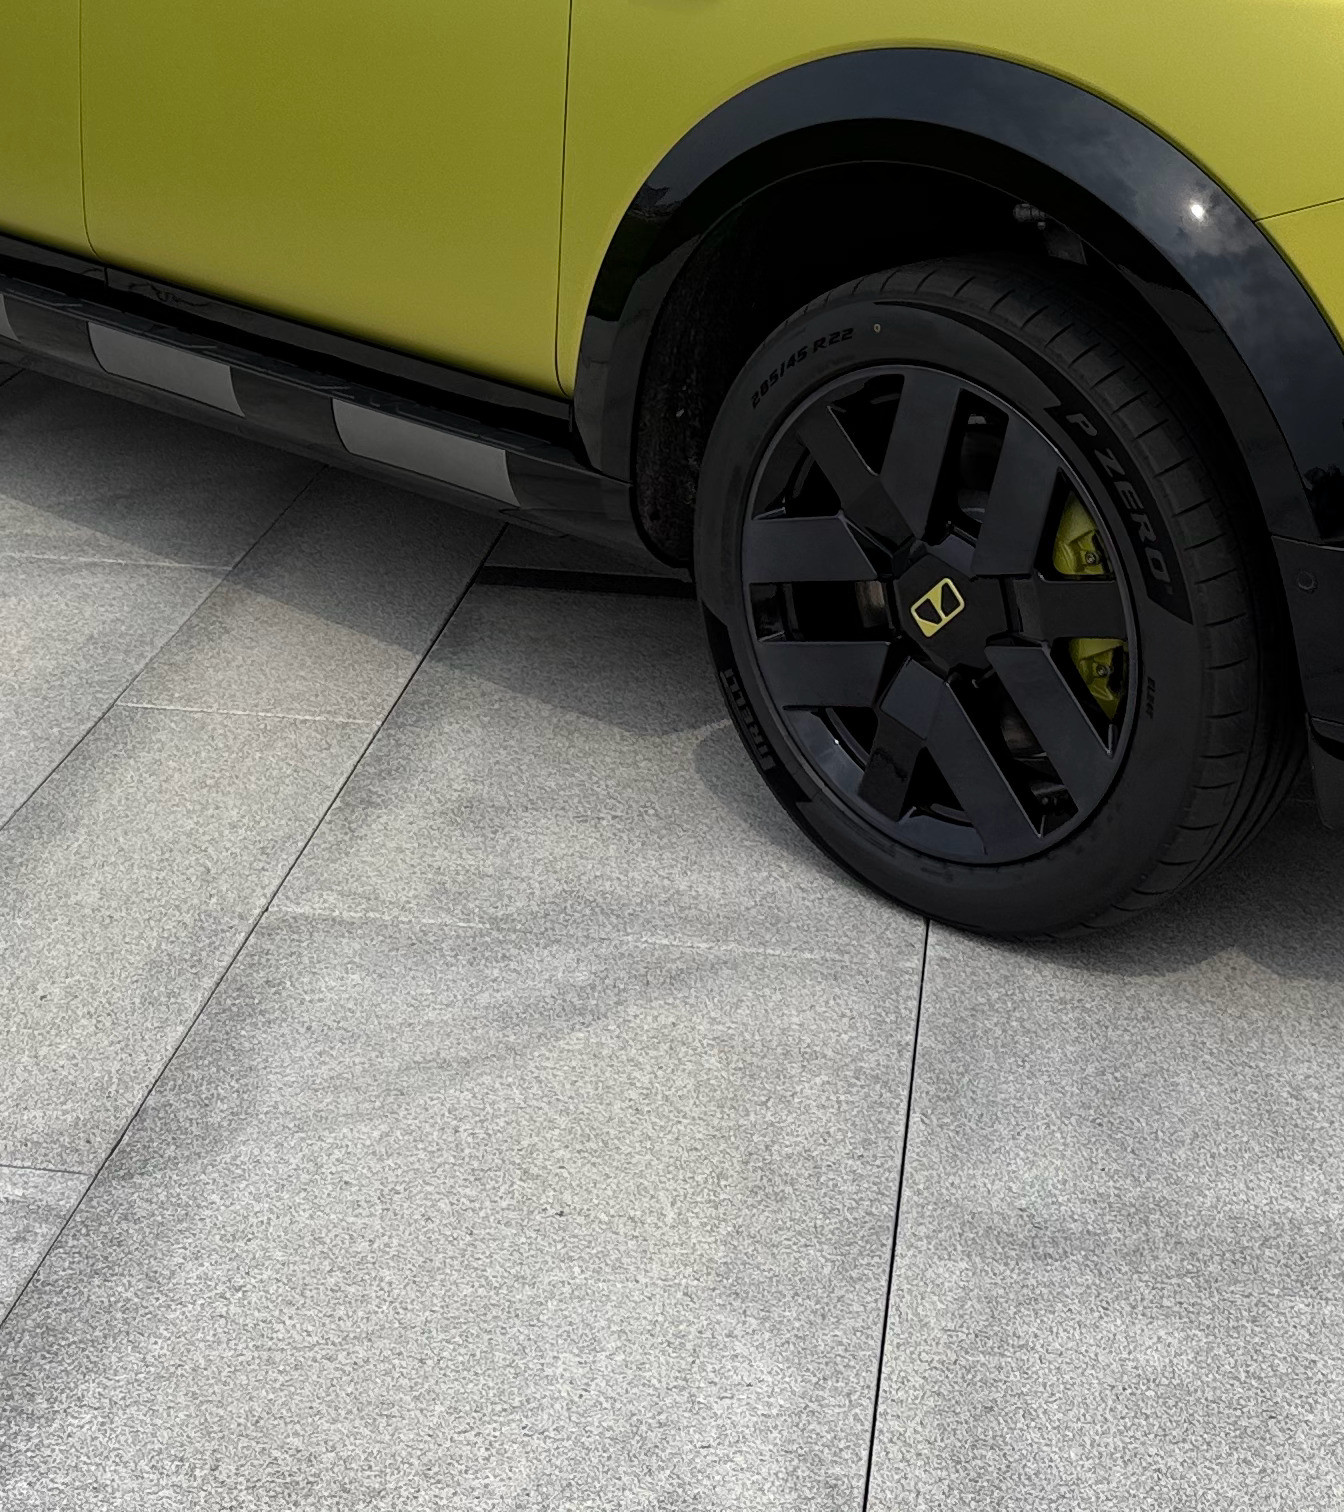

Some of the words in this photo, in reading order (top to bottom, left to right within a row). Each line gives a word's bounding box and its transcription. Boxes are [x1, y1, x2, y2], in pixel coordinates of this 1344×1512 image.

[813, 328, 854, 353] R22
[1066, 413, 1098, 437] P
[1094, 448, 1171, 582] ZERO
